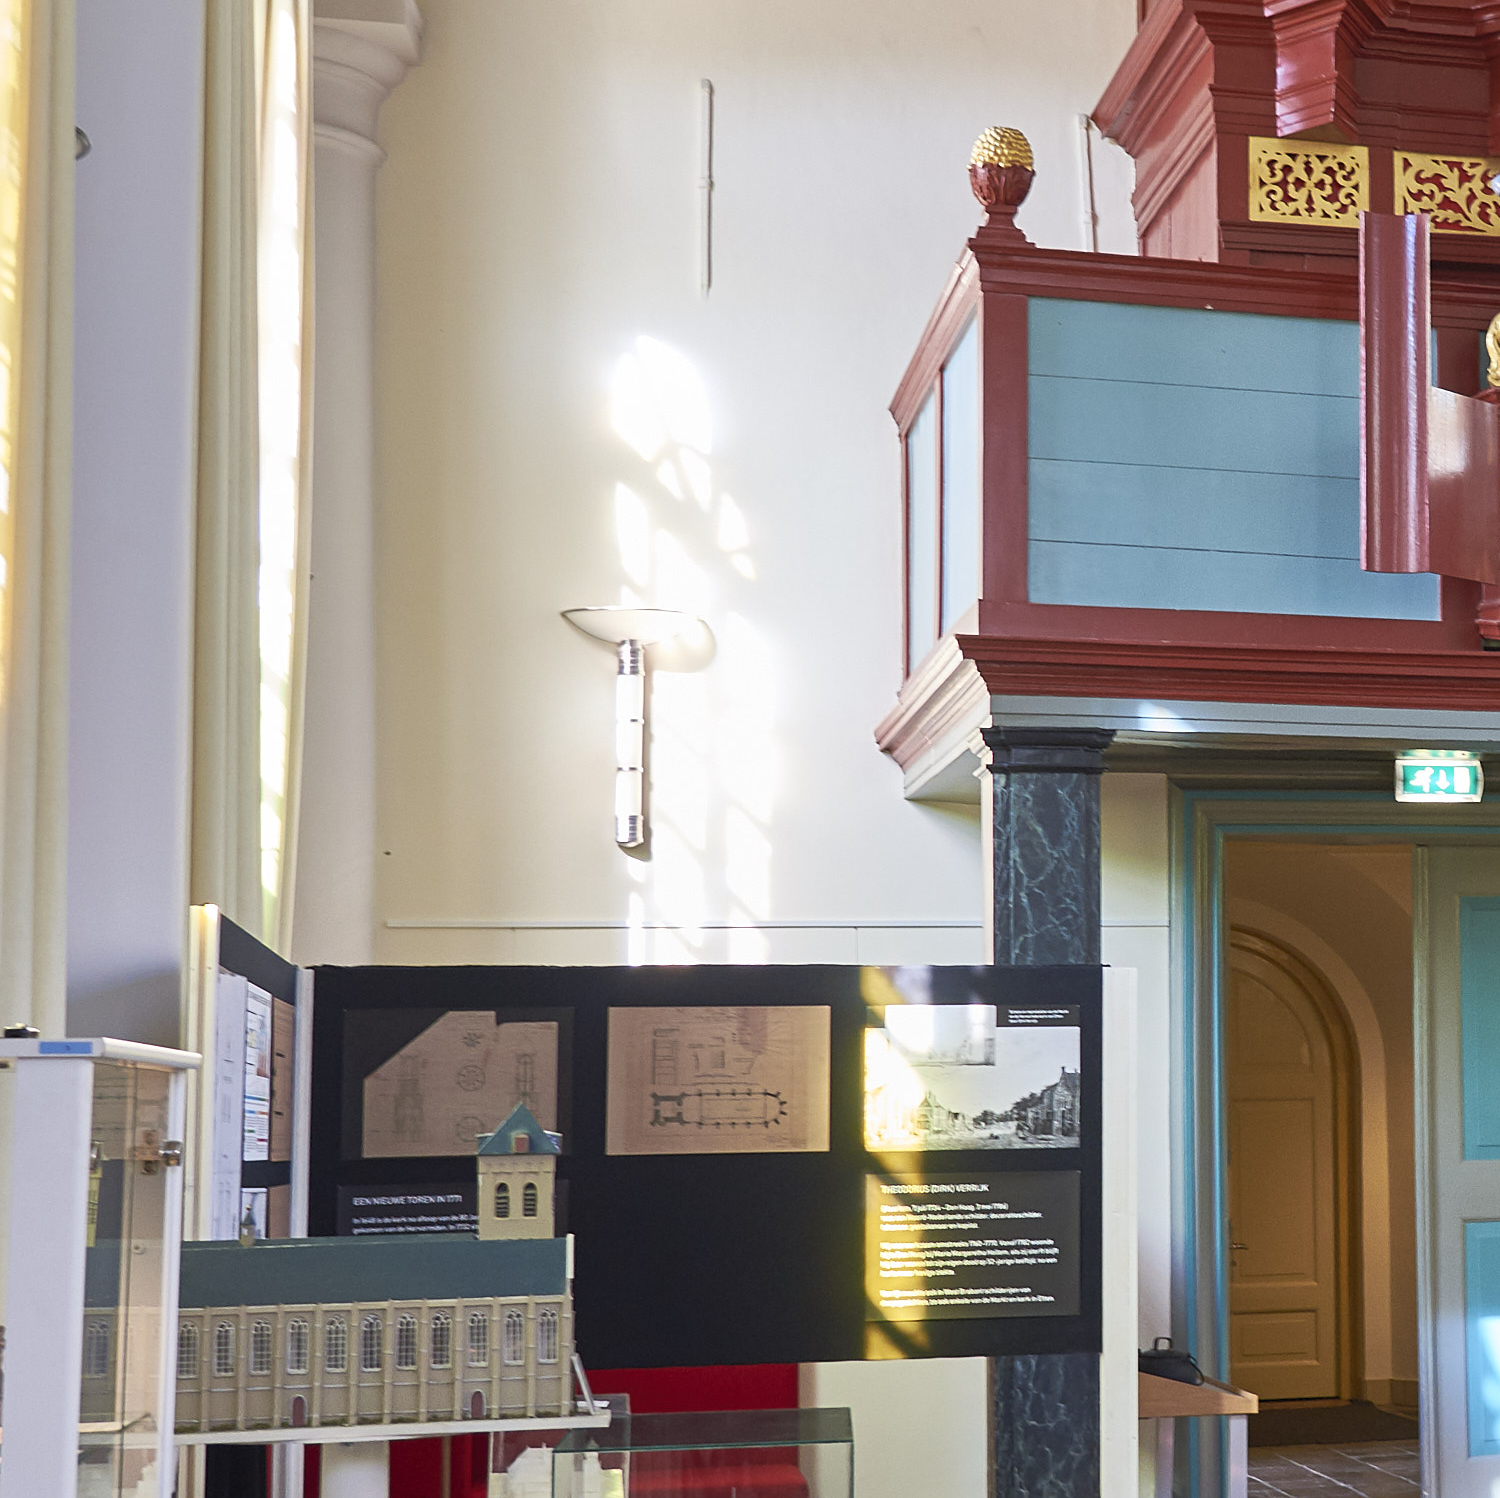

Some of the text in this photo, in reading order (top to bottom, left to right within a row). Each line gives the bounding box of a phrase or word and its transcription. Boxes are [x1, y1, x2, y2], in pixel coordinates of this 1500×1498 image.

[880, 1184, 930, 1194] THEODORUS
[955, 1184, 989, 1192] VERRIJK
[352, 1197, 371, 1205] EEN
[371, 1196, 406, 1205] NIEUWE
[406, 1195, 435, 1204] TOREN
